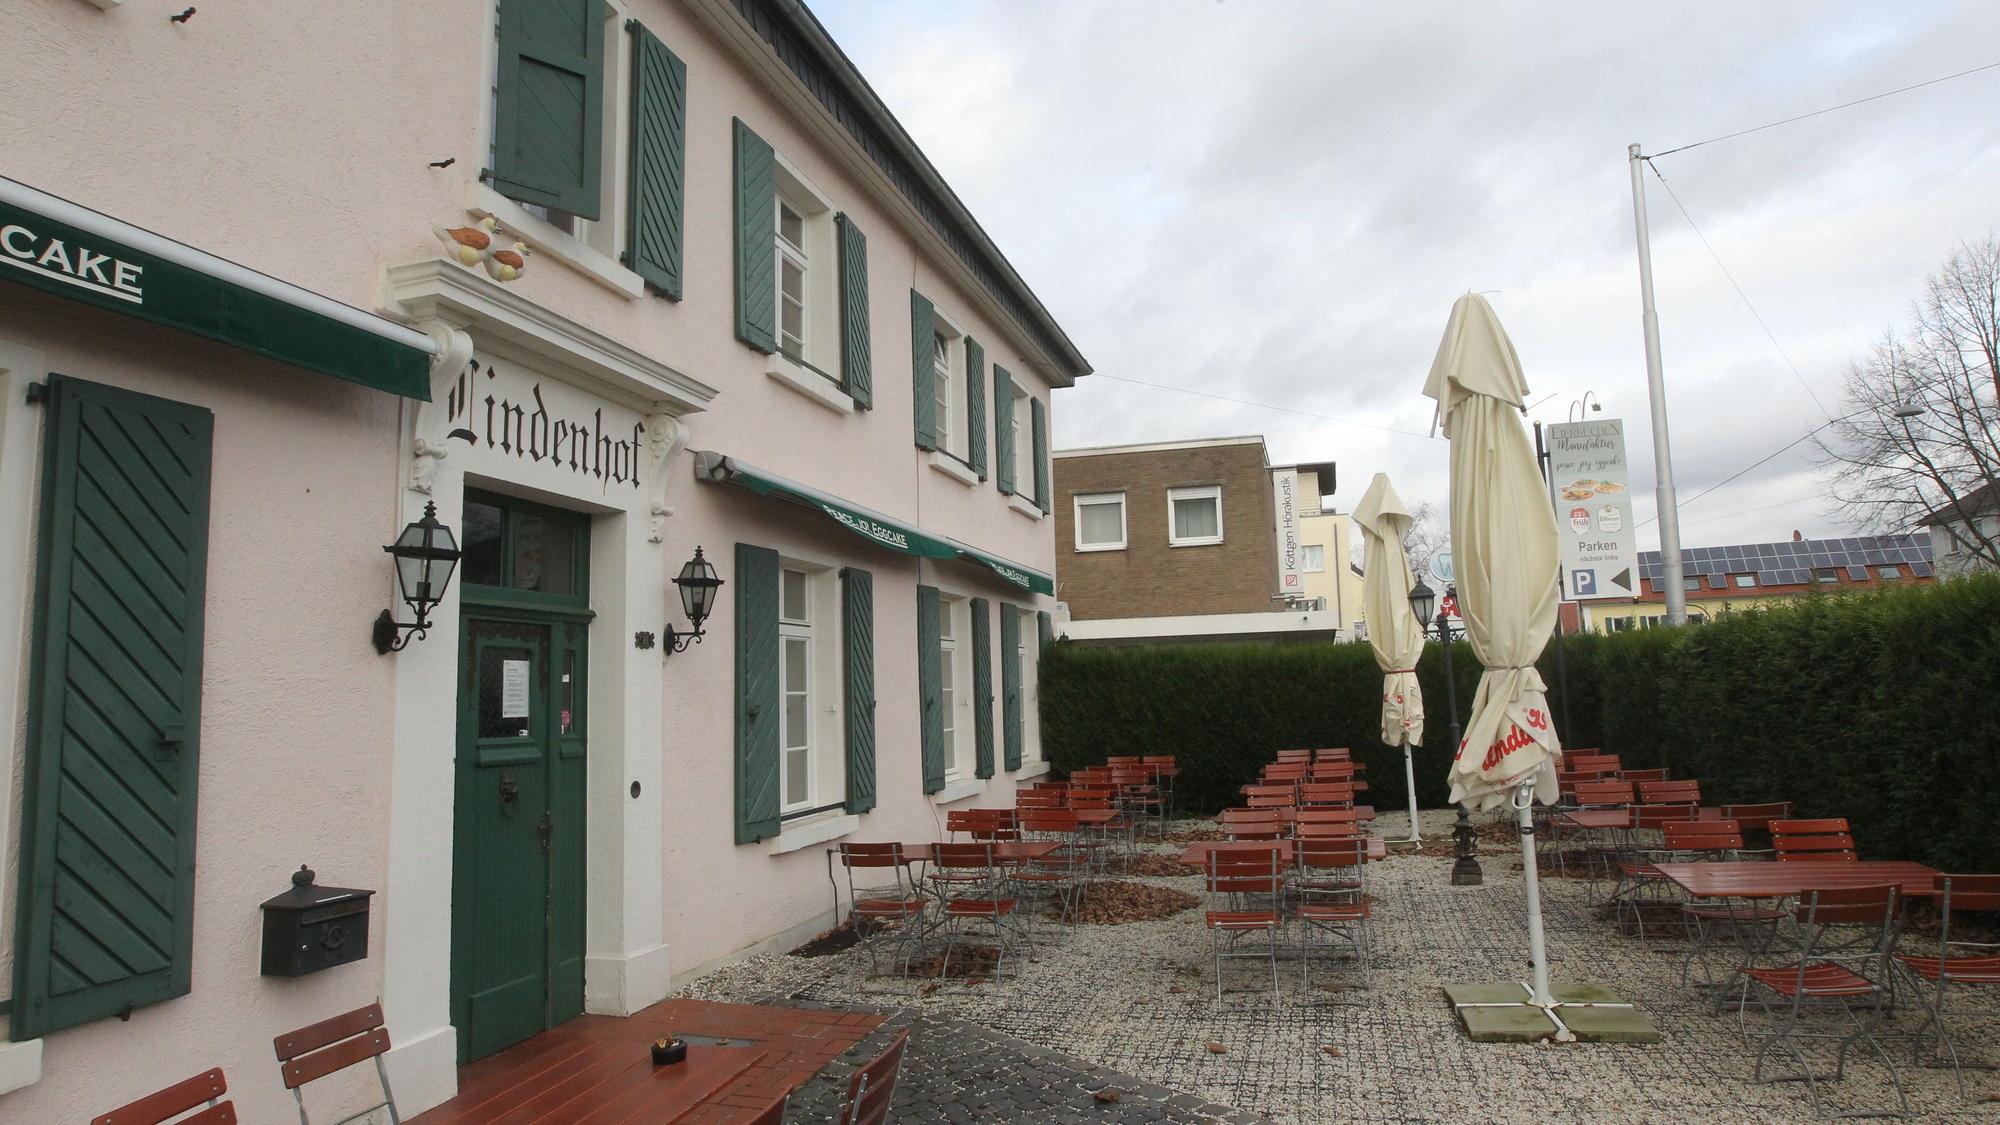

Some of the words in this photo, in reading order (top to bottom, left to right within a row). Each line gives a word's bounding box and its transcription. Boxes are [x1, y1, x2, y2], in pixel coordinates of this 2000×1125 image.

[446, 358, 646, 495] Lindenhof
[1280, 475, 1294, 529] Hörakustik
[1285, 530, 1297, 571] Köttgen
[1578, 541, 1617, 552] Parken
[1575, 572, 1591, 593] P
